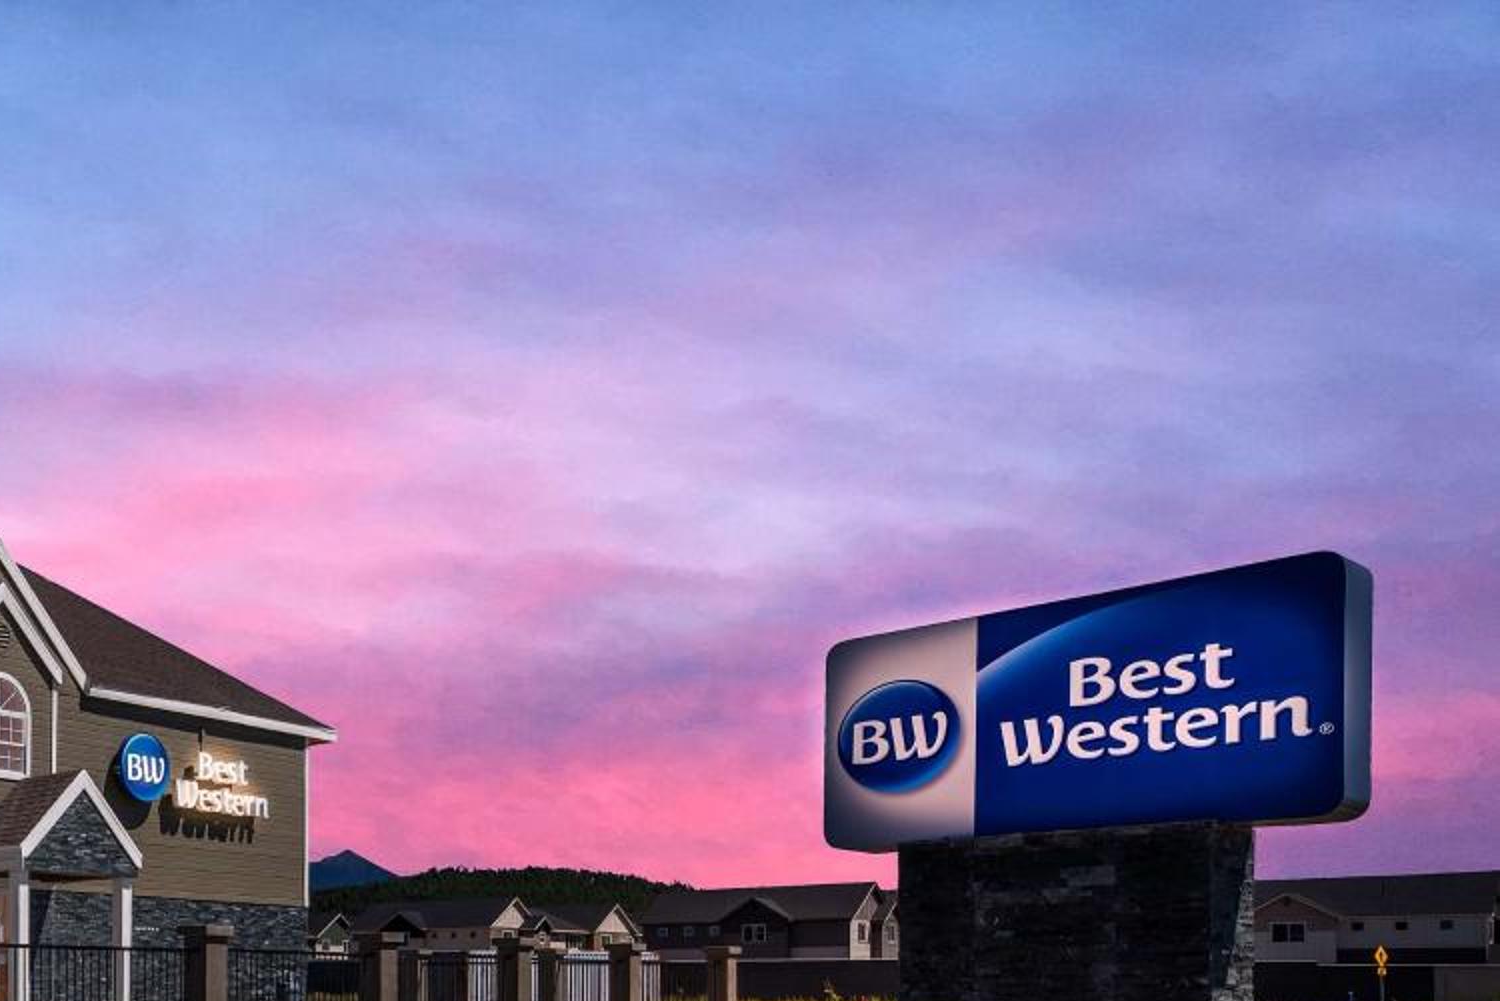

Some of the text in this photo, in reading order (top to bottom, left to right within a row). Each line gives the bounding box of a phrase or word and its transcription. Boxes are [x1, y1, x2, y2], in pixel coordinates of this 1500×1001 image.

[1069, 643, 1236, 707] Best
[851, 711, 948, 766] BW
[127, 753, 164, 784] BW
[198, 751, 249, 785] Best
[175, 778, 269, 819] Western
